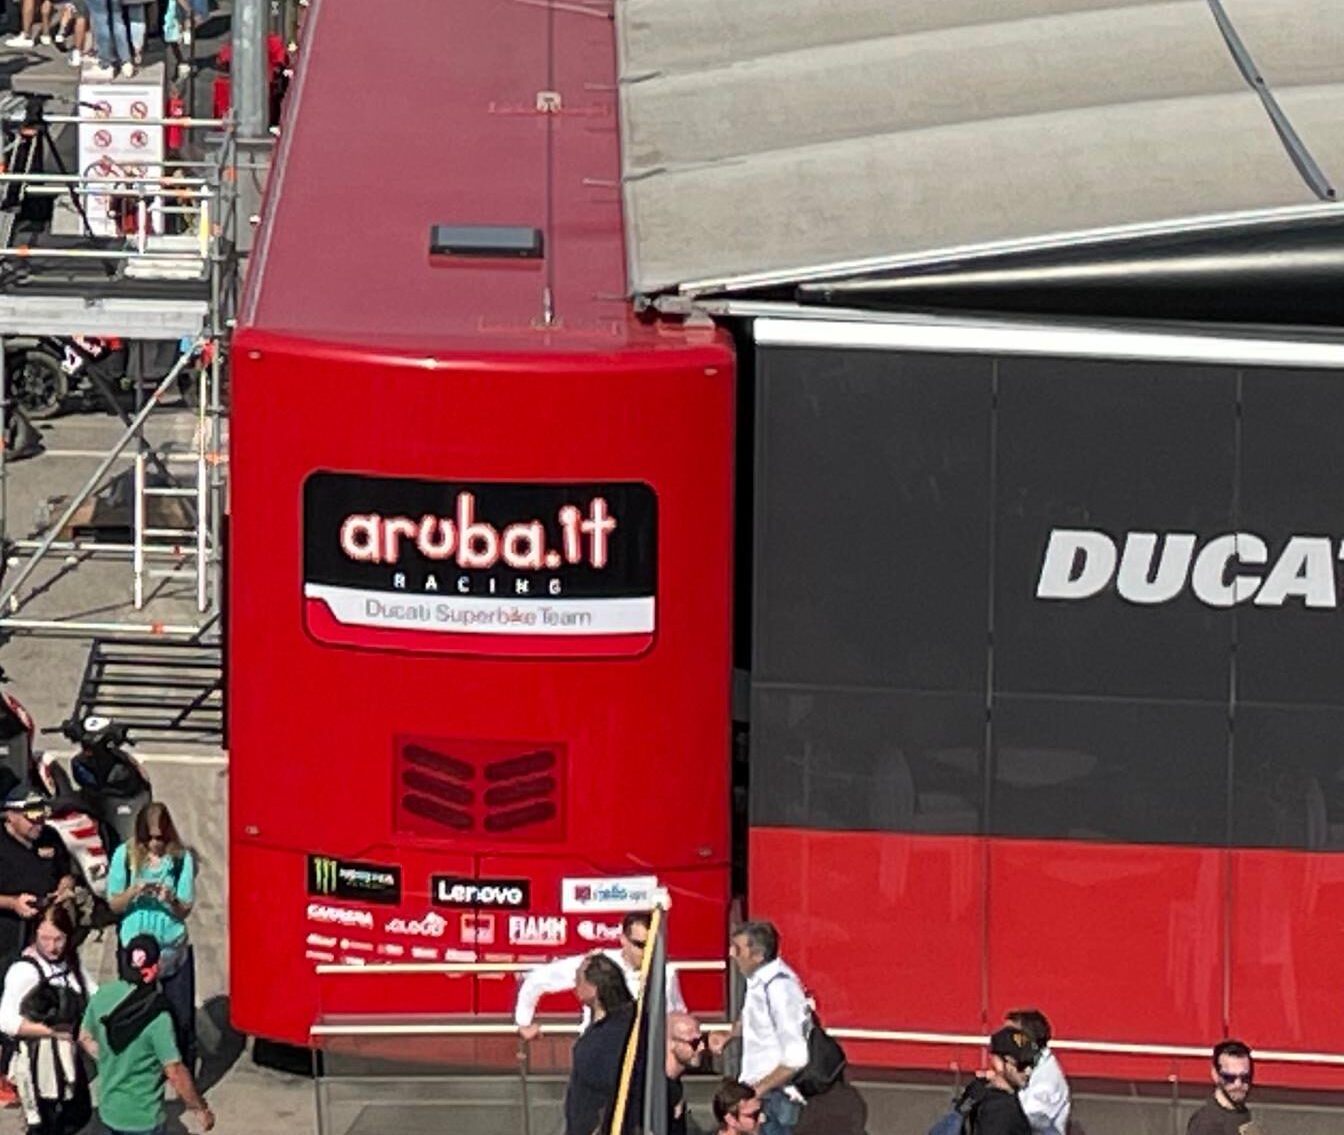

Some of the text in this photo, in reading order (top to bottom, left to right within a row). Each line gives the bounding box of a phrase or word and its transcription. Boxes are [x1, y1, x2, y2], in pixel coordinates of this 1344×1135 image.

[339, 491, 616, 569] aruba.it
[1036, 528, 1344, 608] DUCA
[393, 572, 562, 595] RACING
[365, 598, 592, 627] Ducati Superbike Team
[437, 879, 522, 905] Lenovo
